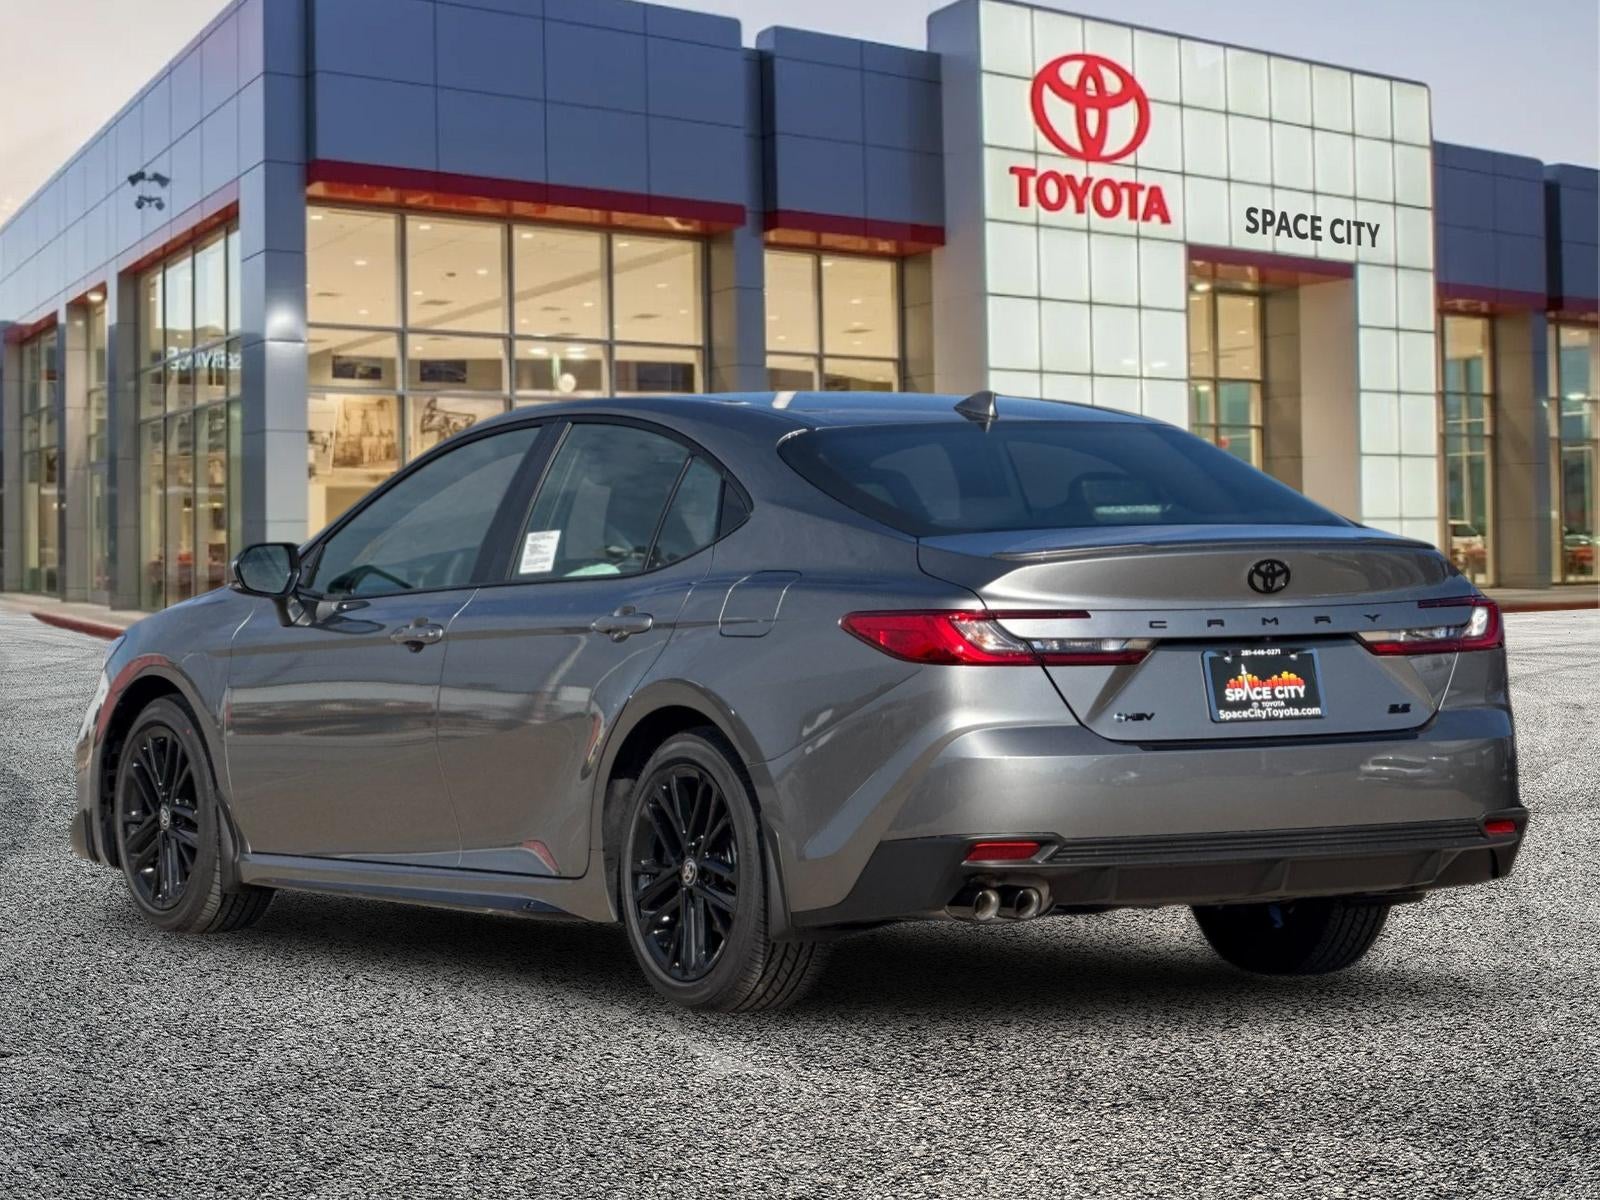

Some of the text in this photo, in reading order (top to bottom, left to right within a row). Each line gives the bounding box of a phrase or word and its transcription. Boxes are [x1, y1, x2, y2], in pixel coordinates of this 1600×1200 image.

[1009, 166, 1171, 225] TOYOTA
[1245, 206, 1381, 249] SPACE CITY
[1149, 613, 1382, 629] CAMRY
[1225, 685, 1306, 702] SPACE CITY
[1219, 707, 1321, 720] SpaceCityToyota.com
